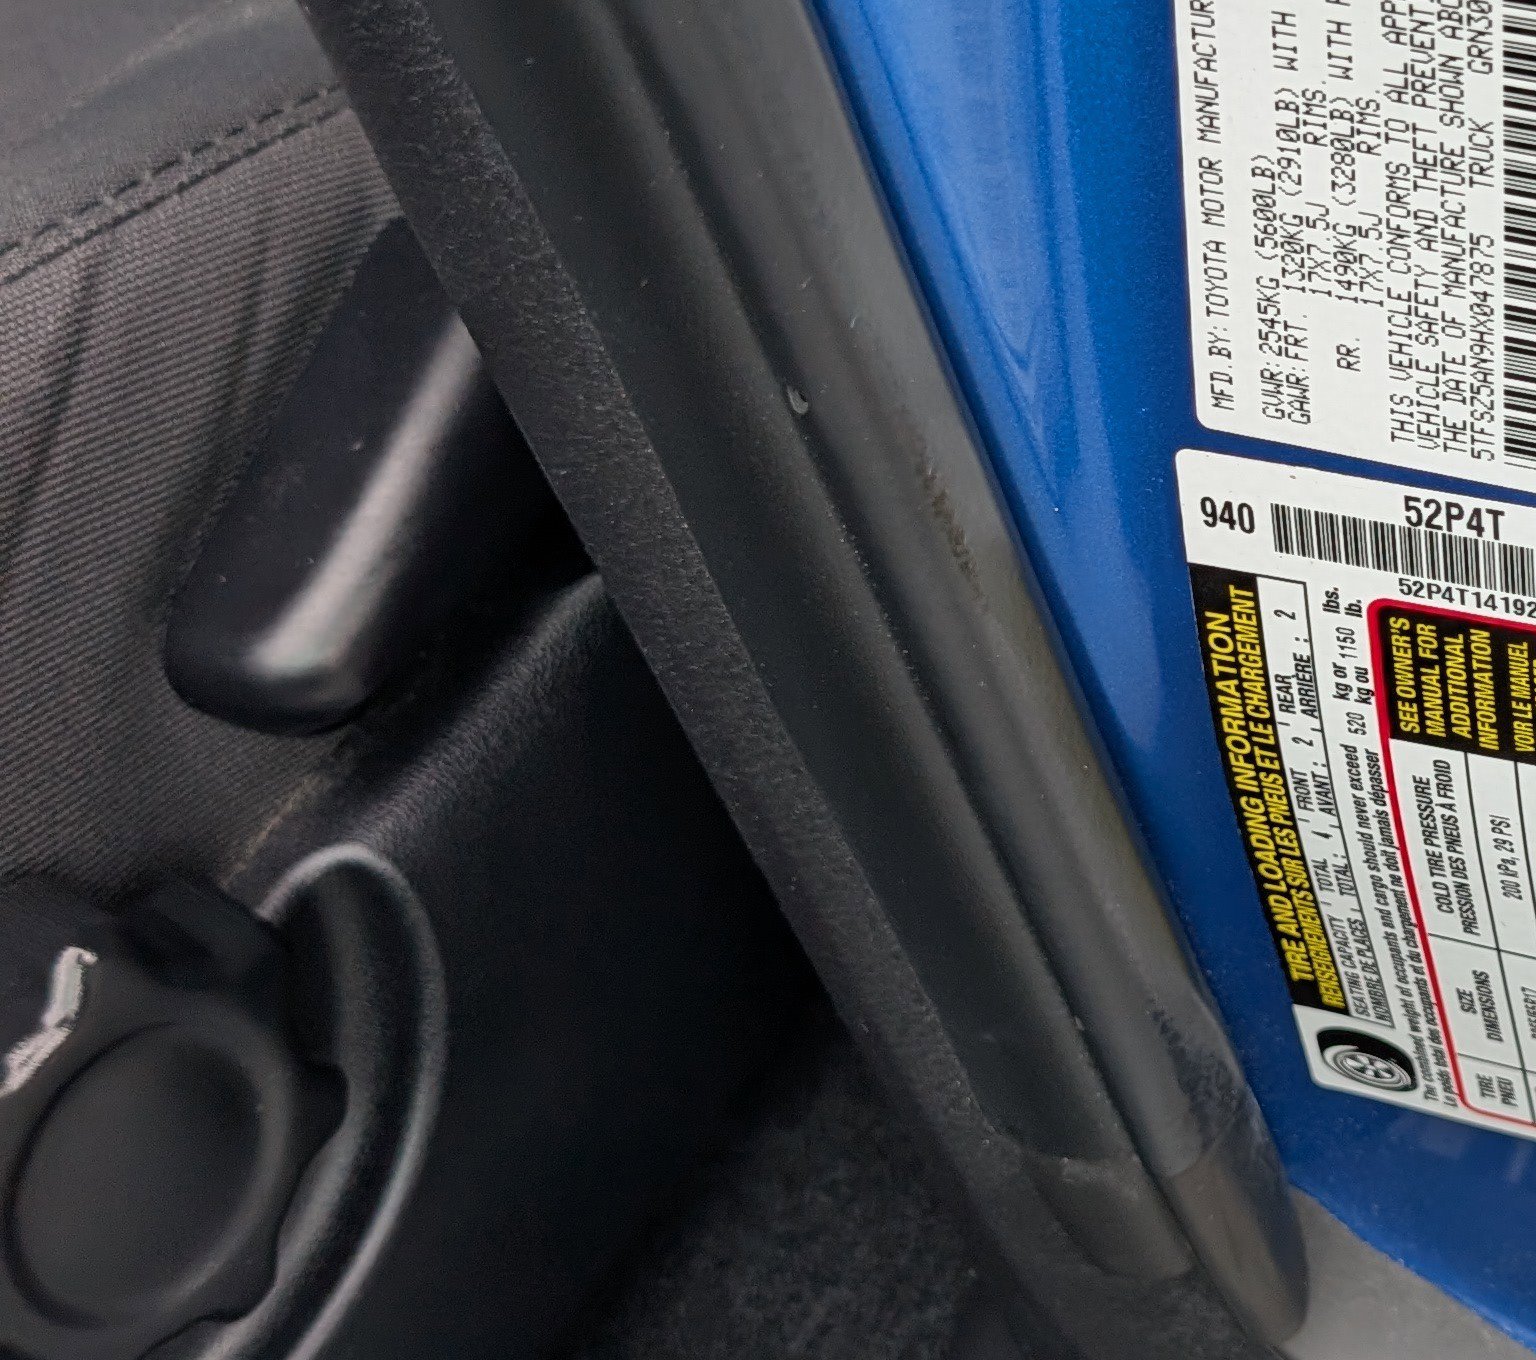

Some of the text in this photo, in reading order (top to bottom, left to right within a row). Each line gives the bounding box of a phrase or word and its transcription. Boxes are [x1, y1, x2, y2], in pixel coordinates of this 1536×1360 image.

[1270, 10, 1299, 72] WITH
[1326, 19, 1354, 81] WITH
[1382, 62, 1410, 105] ALL
[1437, 53, 1465, 129] SHOWN
[1274, 87, 1303, 197] (2910LB)
[1328, 96, 1357, 207] (3280LB)
[1383, 117, 1411, 145] TO
[1411, 122, 1439, 193] THEFT
[1468, 117, 1495, 189] TRUCK
[1198, 156, 1226, 228] MOTOR
[1250, 154, 1279, 261] (5600LB)
[1301, 80, 1333, 298] 17X7.5J RIMS.
[1354, 90, 1384, 308] 17X7.5J RIMS.
[1384, 161, 1412, 275] CONFORMS
[1412, 208, 1439, 253] AND
[1439, 141, 1467, 300] MANUFACTURE
[1278, 212, 1306, 294] 1320KG
[1331, 222, 1359, 304] 1490KG
[1413, 264, 1440, 348] SAFETY
[1440, 310, 1467, 340] OF
[1335, 338, 1361, 373] RR.
[1386, 286, 1414, 382] VEHICLE
[1468, 232, 1495, 462] 5TFSZ5AN9HX047875
[1414, 358, 1441, 451] VEHICLE
[1441, 350, 1467, 406] DATE
[1389, 393, 1415, 443] THIS
[1442, 415, 1468, 453] THE
[1200, 495, 1506, 541] 940 52P4T
[1273, 609, 1297, 621] 2
[1321, 587, 1341, 615] lbs.
[1344, 599, 1363, 619] lb.
[1332, 661, 1348, 679] or
[1335, 626, 1358, 659] 1150
[1332, 681, 1357, 703] kg
[1354, 665, 1370, 684] ou
[1354, 686, 1374, 706] kg
[1389, 616, 1421, 734] SEE OWNER'S
[1416, 623, 1447, 738] MANUAL FOR
[1443, 633, 1473, 739] ADDITIONAL
[1469, 628, 1500, 751] INFORMATION
[1507, 641, 1536, 752] VOIR LE MANUEL
[1291, 736, 1314, 747] 2
[1345, 711, 1367, 736] 520
[1339, 743, 1364, 792] exceed
[1364, 748, 1388, 807] dépasser
[1204, 611, 1315, 981] TIRE AND LOADING INFORMATION
[1228, 584, 1346, 1007] RENSEIGNEMENTS SUR LES PNEUS ET LE CHARGEMENT
[1351, 793, 1372, 830] never
[1274, 673, 1371, 1018] SEATING CAPACITY TOTAL FRONT REAR
[1311, 830, 1333, 840] 4
[1355, 830, 1381, 873] should
[1372, 809, 1398, 851] jamais
[1412, 774, 1455, 914] COLD TIRE PRESSURE
[1432, 759, 1480, 937] PRESSION DES PNEUS À FROID
[1489, 814, 1523, 901] 200 kPa, 29 PSI
[1380, 849, 1401, 872] doit
[1369, 874, 1390, 907] cargo
[1346, 917, 1375, 962] PLACES
[1374, 907, 1396, 930] and
[1358, 959, 1380, 977] DE
[1382, 930, 1410, 985] occupants
[1363, 975, 1393, 1025] NOMBRE
[1455, 987, 1478, 1015] SIZE
[1471, 970, 1504, 1043] DIMENSIONS
[1476, 1073, 1496, 1099] TIRE
[1496, 1076, 1518, 1107] PNEU
